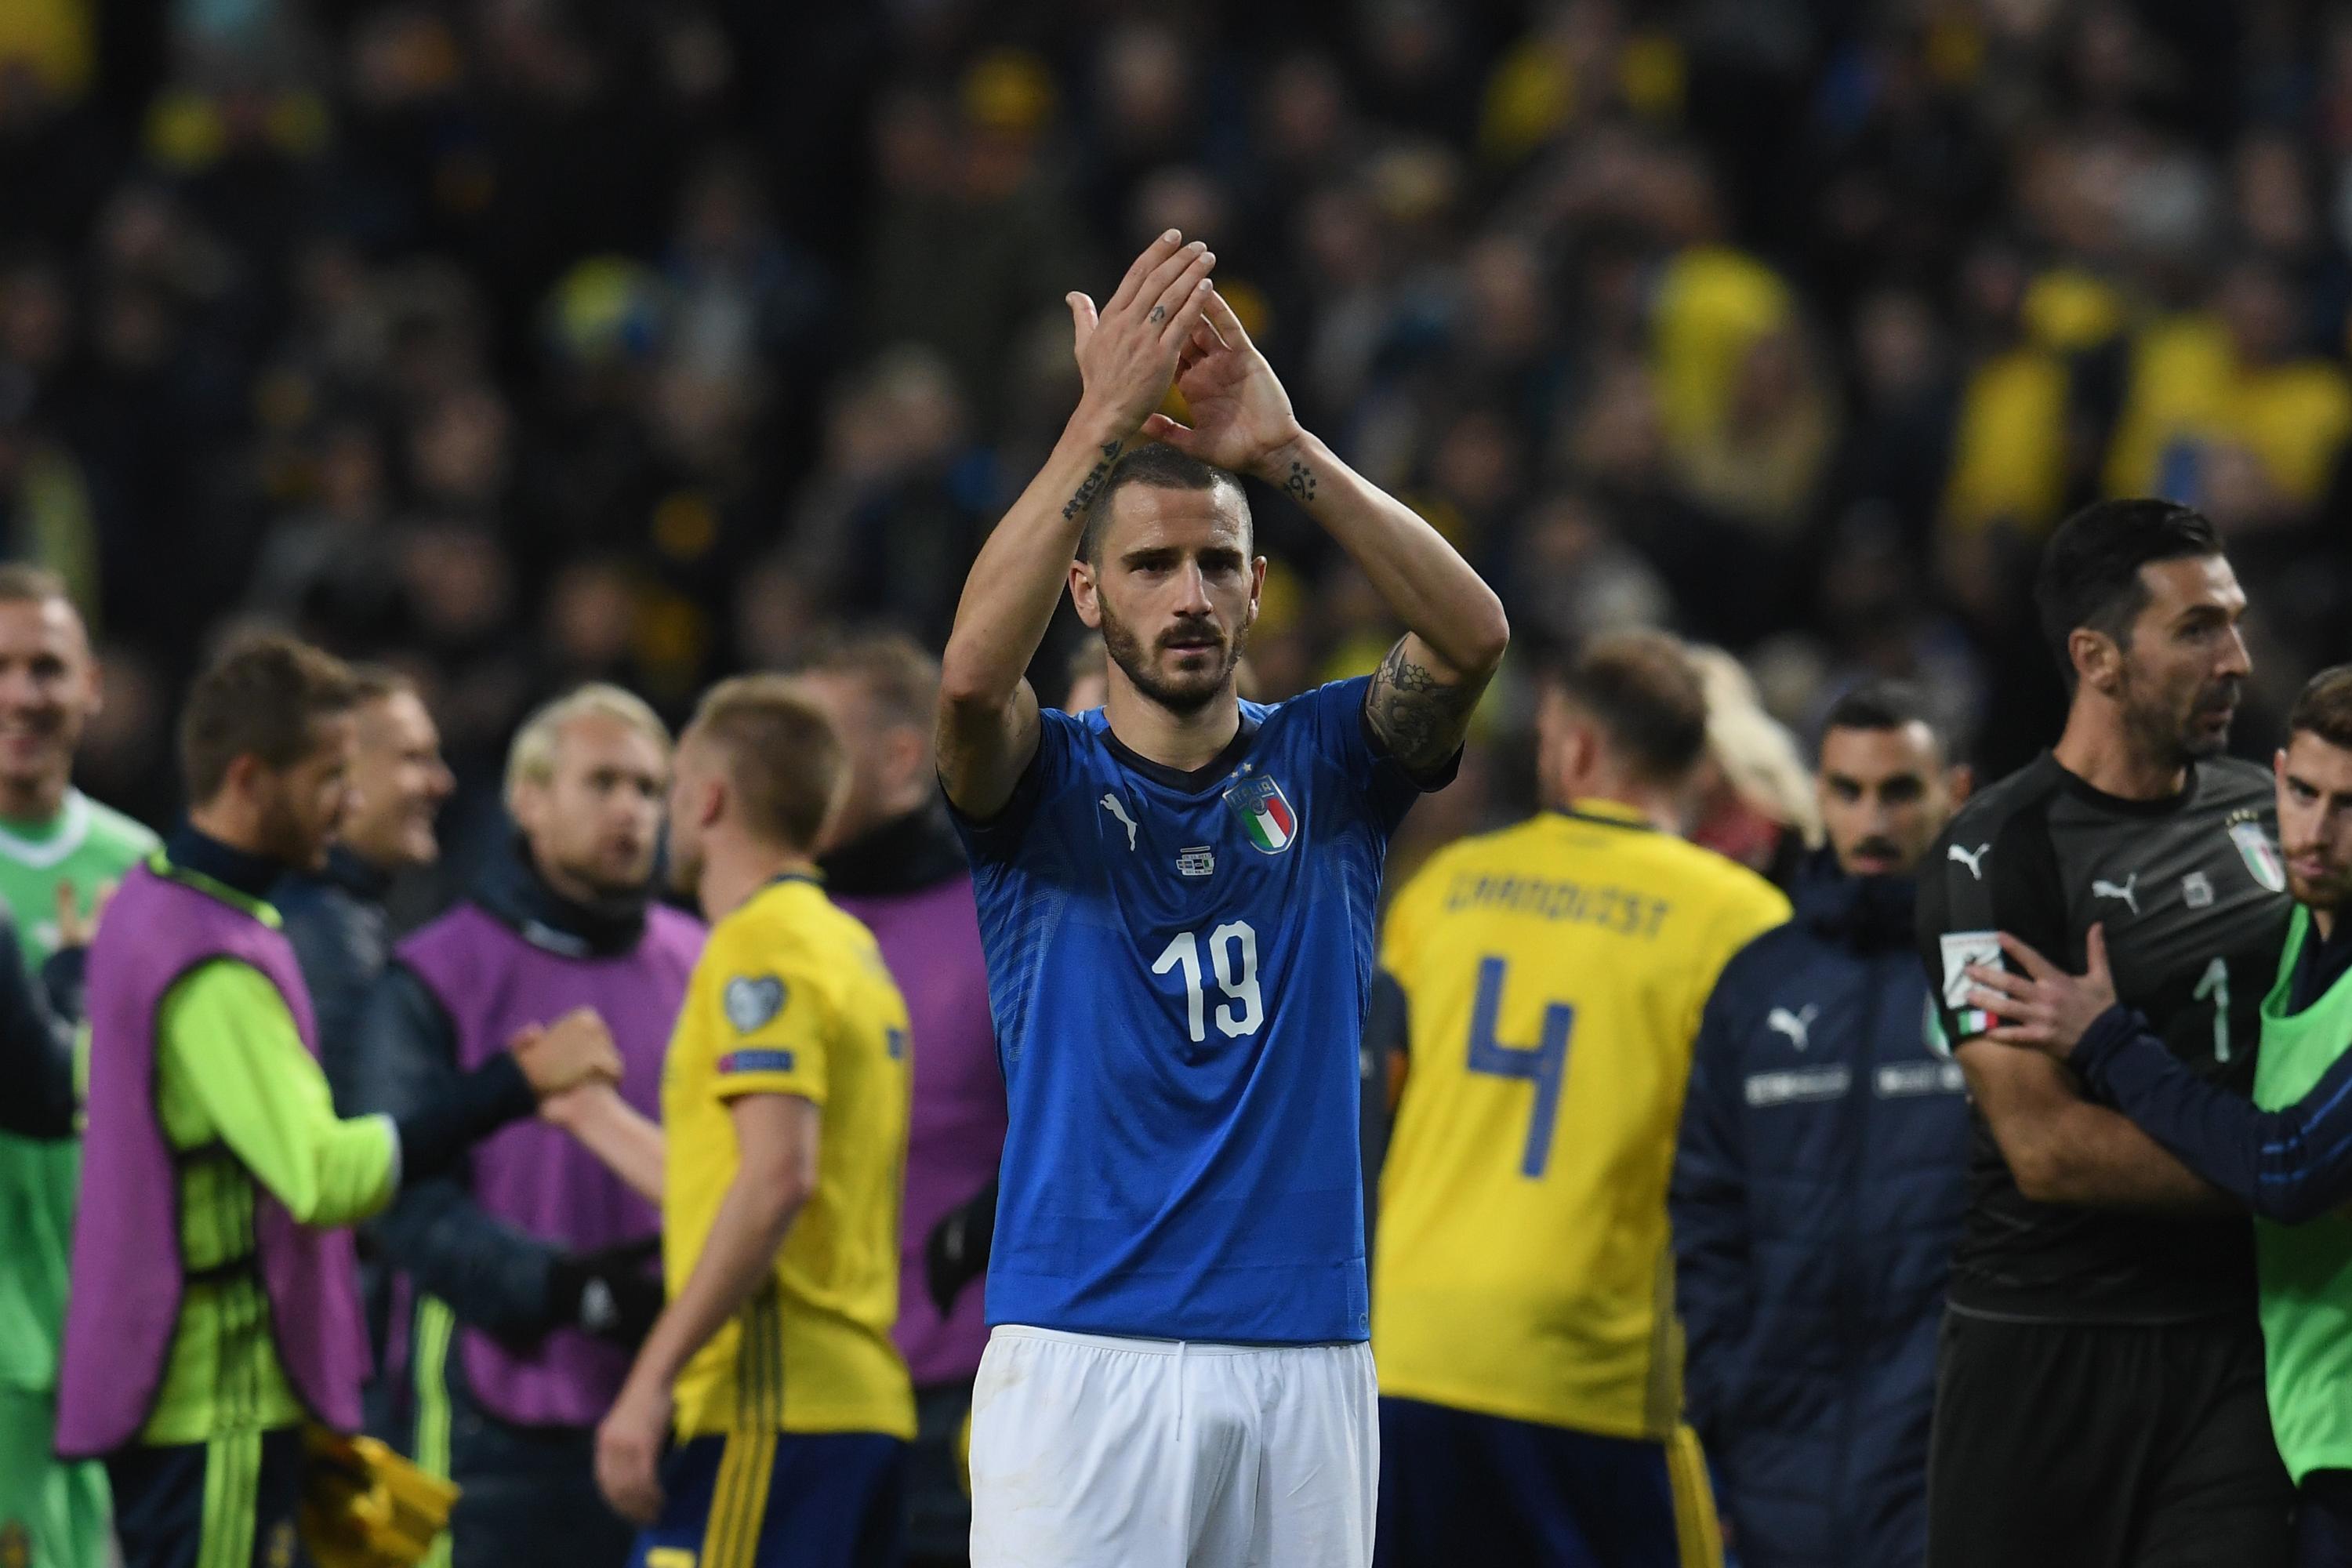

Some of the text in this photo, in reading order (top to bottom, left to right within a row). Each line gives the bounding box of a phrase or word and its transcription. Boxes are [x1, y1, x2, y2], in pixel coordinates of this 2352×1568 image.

[1151, 920, 1265, 1042] 19
[2193, 956, 2230, 1064] 1
[1466, 956, 1575, 1180] 4
